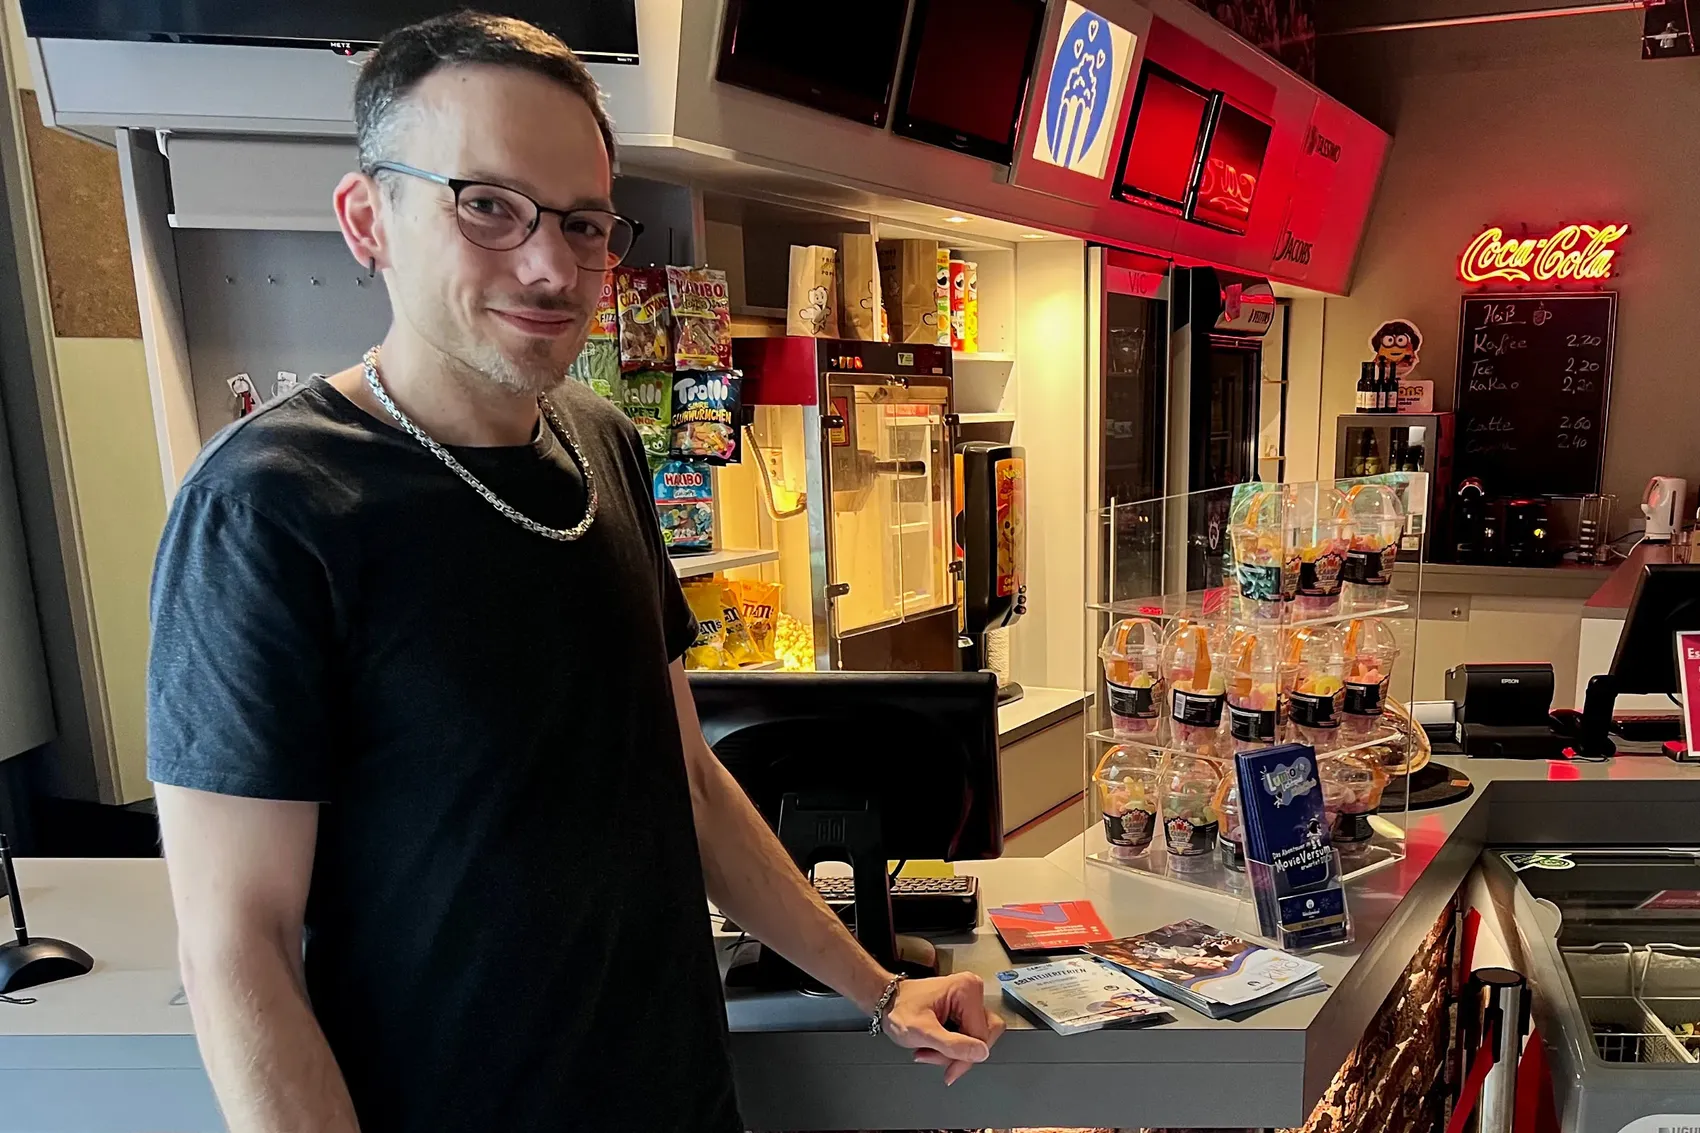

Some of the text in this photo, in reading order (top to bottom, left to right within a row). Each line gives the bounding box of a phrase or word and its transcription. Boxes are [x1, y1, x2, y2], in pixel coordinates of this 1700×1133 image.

[675, 279, 725, 298] HARIBO
[1472, 358, 1495, 377] Tee
[674, 377, 728, 404] Trolli
[664, 473, 703, 487] HARIBO
[1687, 647, 1700, 659] Es
[1272, 851, 1281, 860] Das
[1281, 842, 1305, 857] Abenteuer
[1274, 845, 1331, 873] MovieVersum
